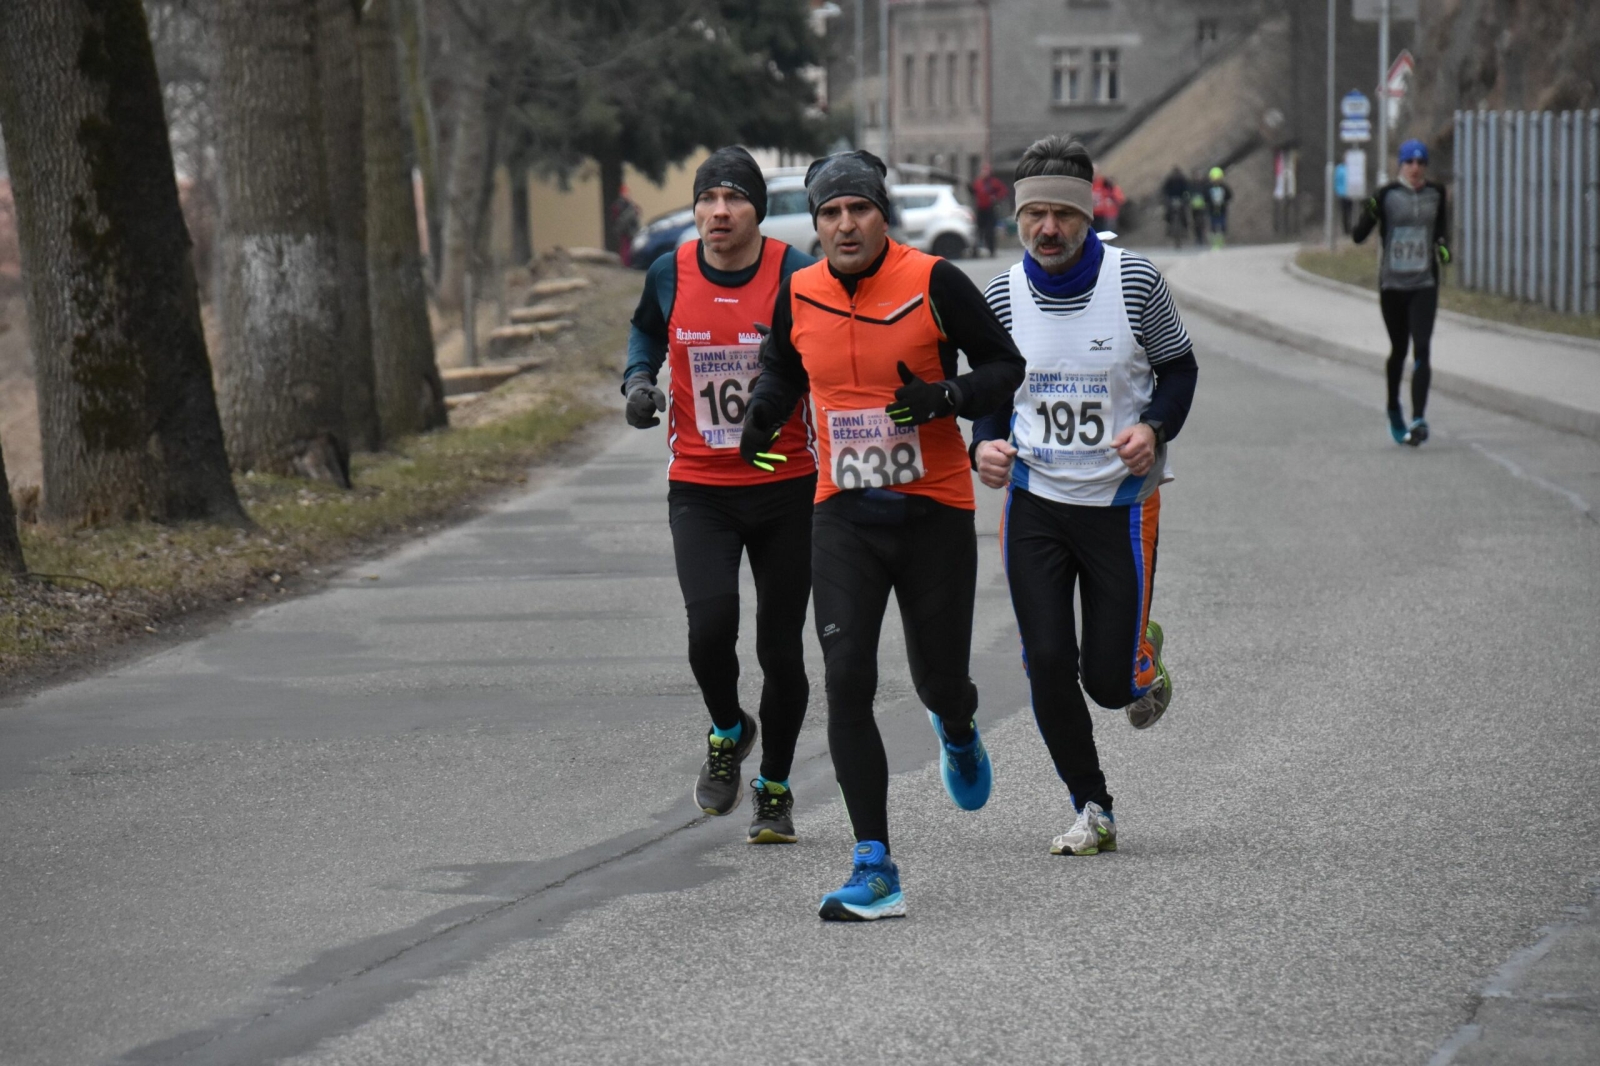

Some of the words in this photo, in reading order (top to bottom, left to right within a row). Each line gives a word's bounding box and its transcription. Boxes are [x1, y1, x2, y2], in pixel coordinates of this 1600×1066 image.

[676, 328, 711, 341] Krakonoš
[693, 350, 726, 362] ZIMNÍ
[694, 362, 743, 373] BĚŽECKÁ
[747, 362, 765, 370] LIG
[1028, 372, 1062, 382] ZIMNÍ
[1029, 381, 1078, 394] BĚŽECKÁ
[1082, 384, 1108, 394] LIGA
[700, 377, 760, 426] 16
[832, 414, 865, 427] ZIMNÍ
[1036, 400, 1105, 446] 195
[833, 426, 882, 440] BĚŽECKÁ
[887, 425, 915, 437] LIGA
[836, 442, 921, 489] 638
